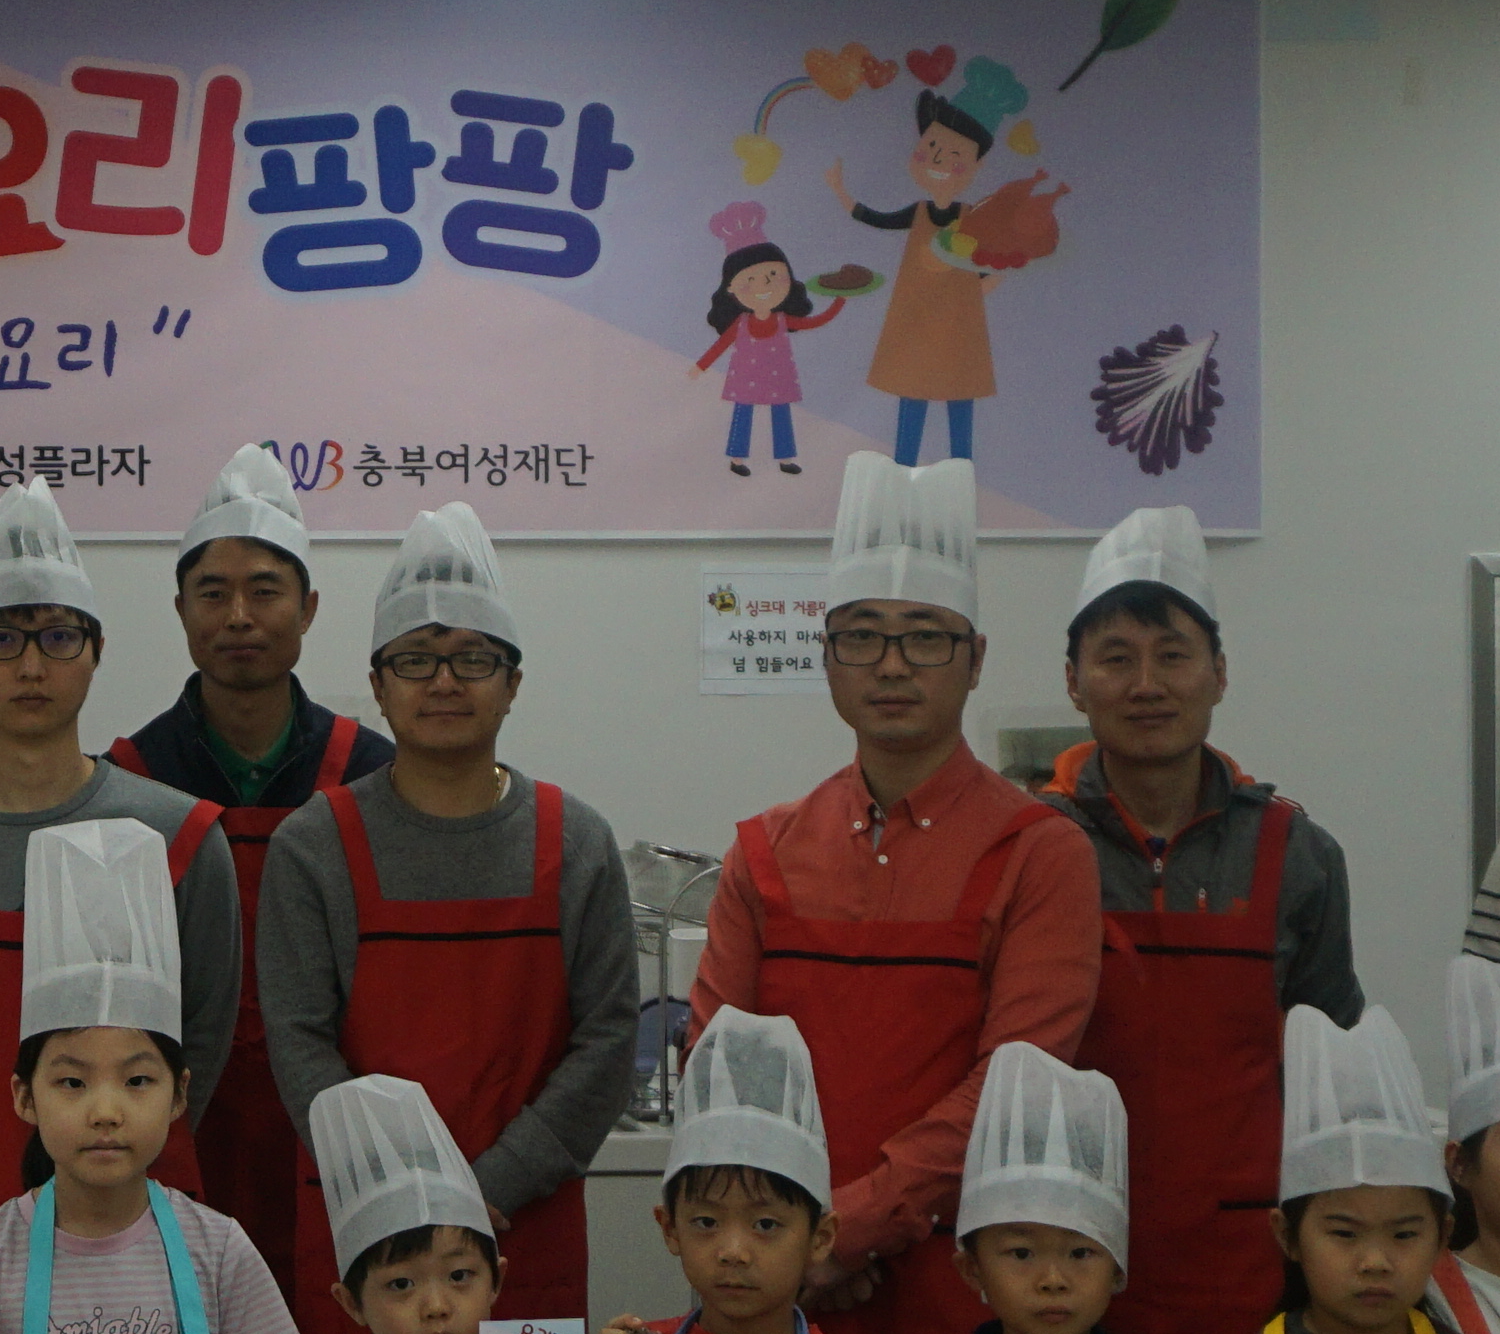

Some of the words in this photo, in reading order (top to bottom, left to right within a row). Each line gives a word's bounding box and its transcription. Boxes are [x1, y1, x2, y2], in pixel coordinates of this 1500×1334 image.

[352, 442, 595, 487] 충북여성재단
[745, 600, 786, 617] 싱크대
[728, 629, 787, 647] 사용하지
[755, 656, 814, 673] 힘들어요
